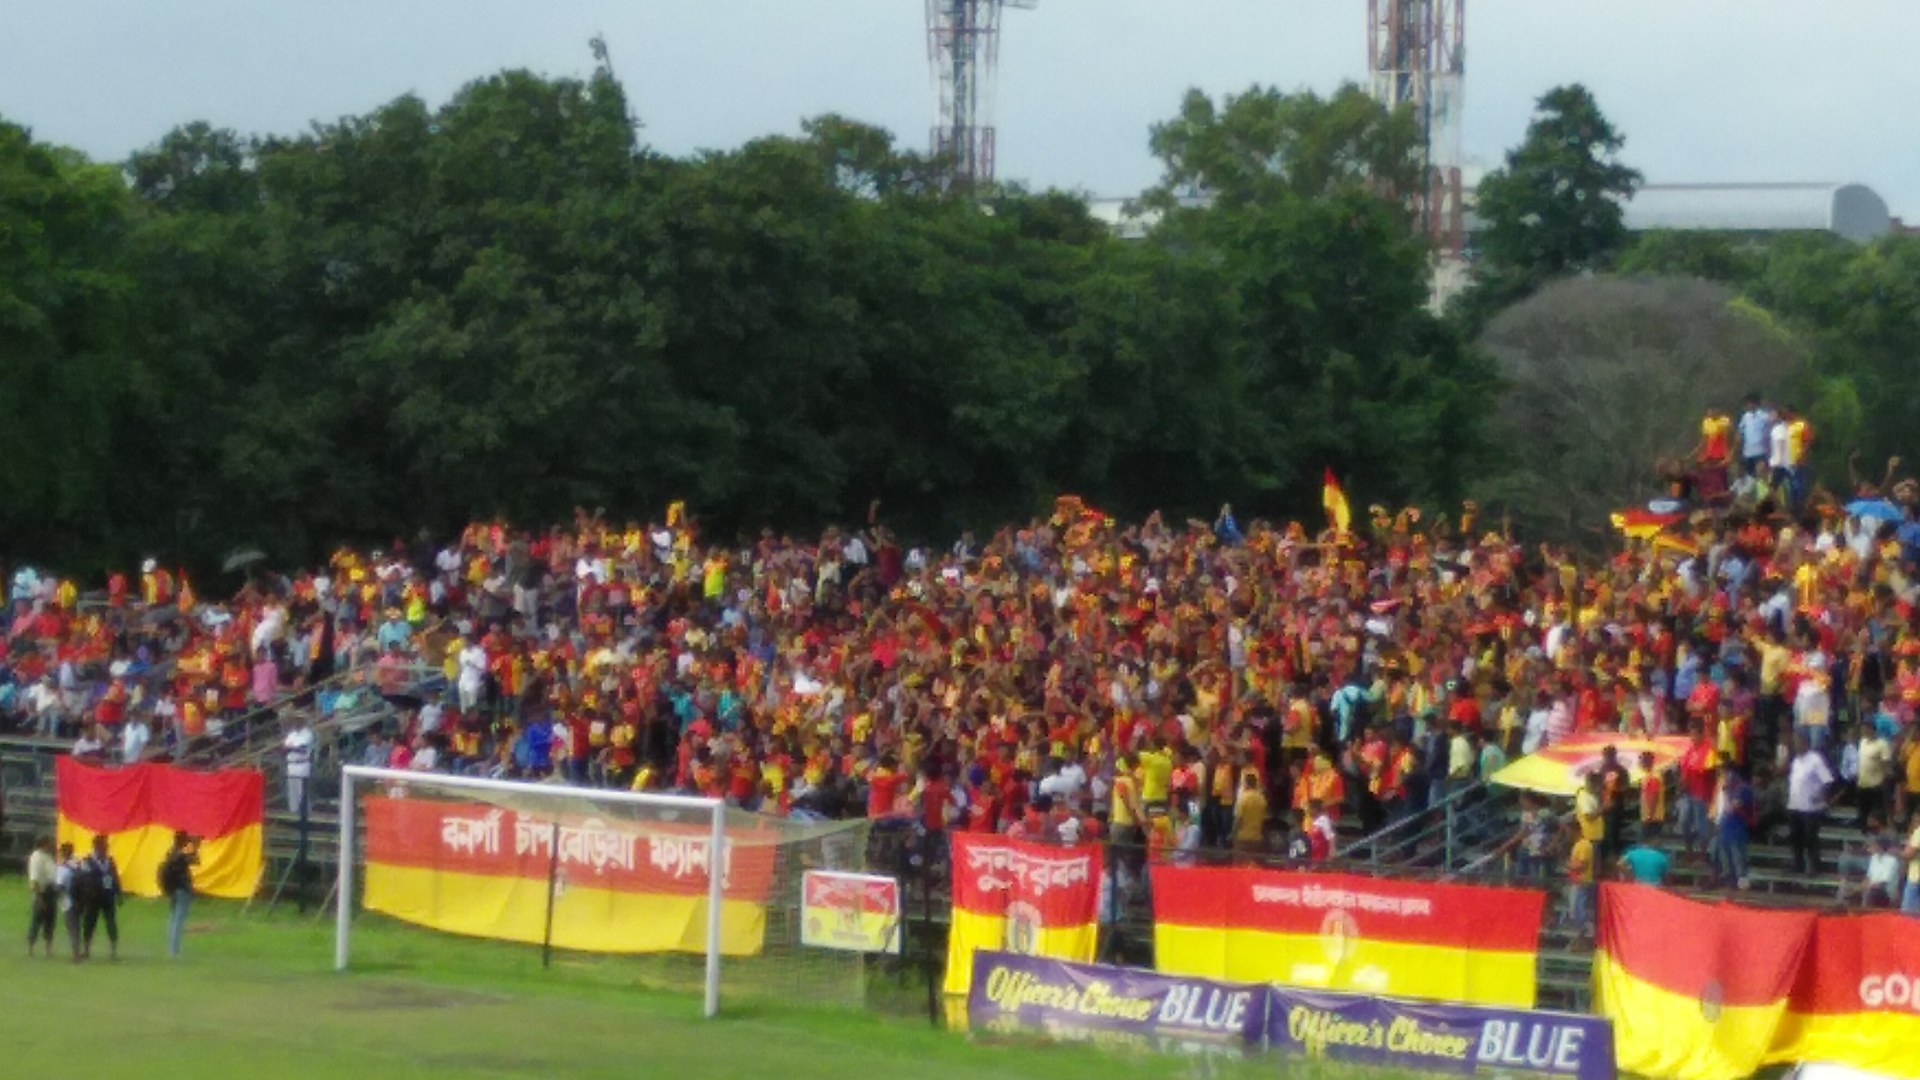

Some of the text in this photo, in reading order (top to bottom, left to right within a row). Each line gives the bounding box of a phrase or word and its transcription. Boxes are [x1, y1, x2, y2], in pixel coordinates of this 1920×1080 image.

[514, 810, 634, 875] চাঁপবেড়িয়া
[986, 966, 1250, 1031] Officer's Choice BLUE
[1289, 1005, 1584, 1070] Officer's Choice BLUE
